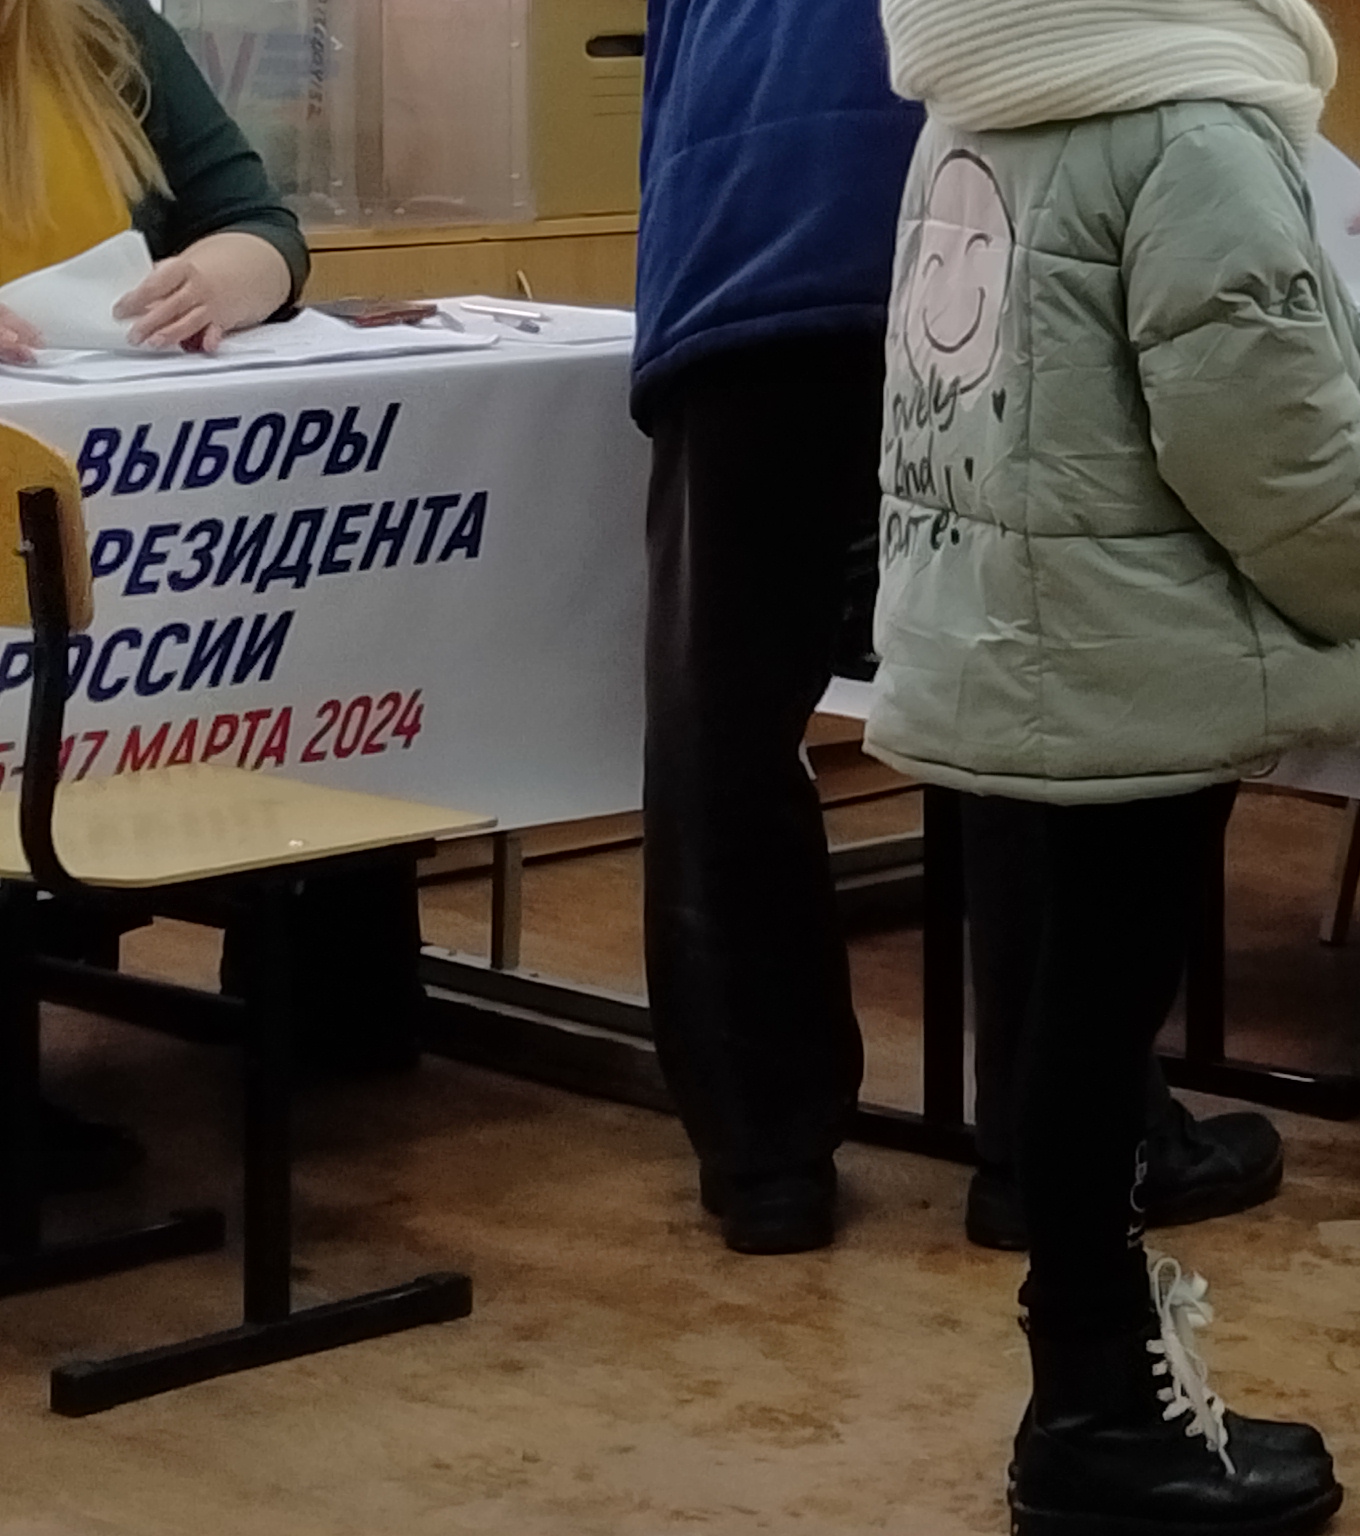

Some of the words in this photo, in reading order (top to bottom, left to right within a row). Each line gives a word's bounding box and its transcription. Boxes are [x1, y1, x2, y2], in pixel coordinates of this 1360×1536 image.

[78, 402, 401, 498] ВЫБОРЫ
[91, 491, 489, 597] РЕЗИДЕНТА
[113, 706, 294, 777] МАРТА
[300, 688, 424, 765] 2024
